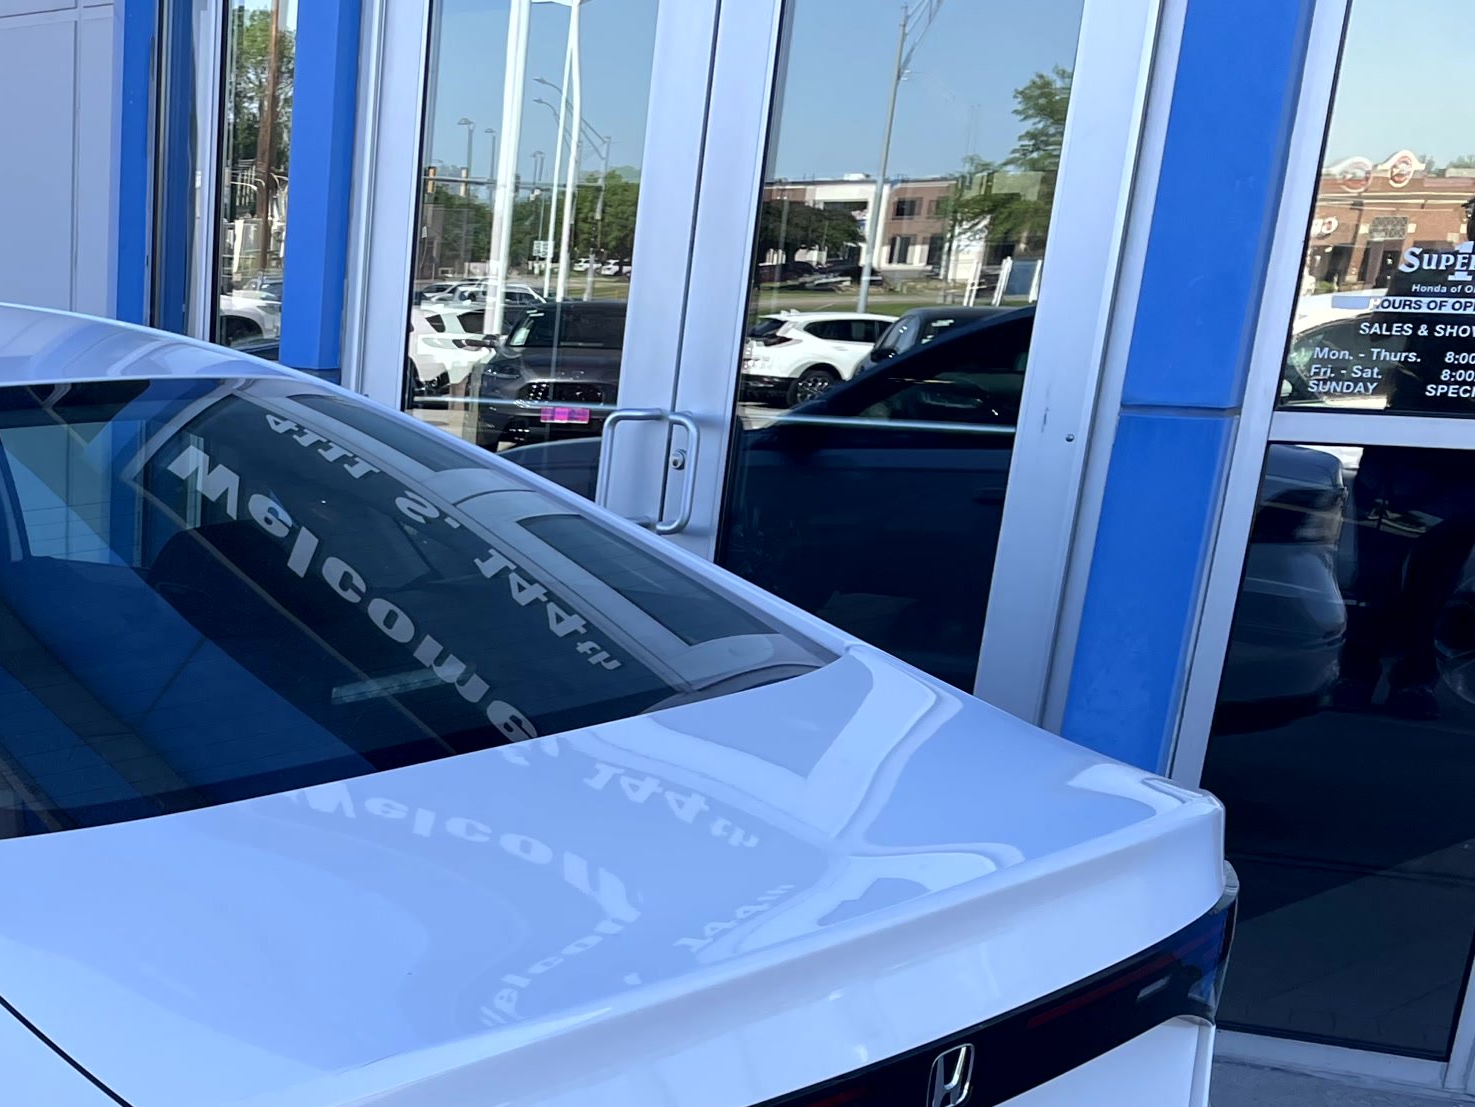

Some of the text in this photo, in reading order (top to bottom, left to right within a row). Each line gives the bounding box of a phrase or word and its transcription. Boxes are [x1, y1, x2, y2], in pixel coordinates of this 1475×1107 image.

[1411, 284, 1447, 293] Honda
[1450, 285, 1463, 293] of
[1426, 299, 1448, 311] OF
[1359, 322, 1413, 336] SALES
[1417, 323, 1429, 336] &
[1313, 346, 1354, 360] Mon.
[1370, 348, 1421, 362] Thurs.
[1310, 364, 1335, 377] Fri.
[1351, 365, 1382, 379] Sat.
[1307, 380, 1379, 395] SUNDAY
